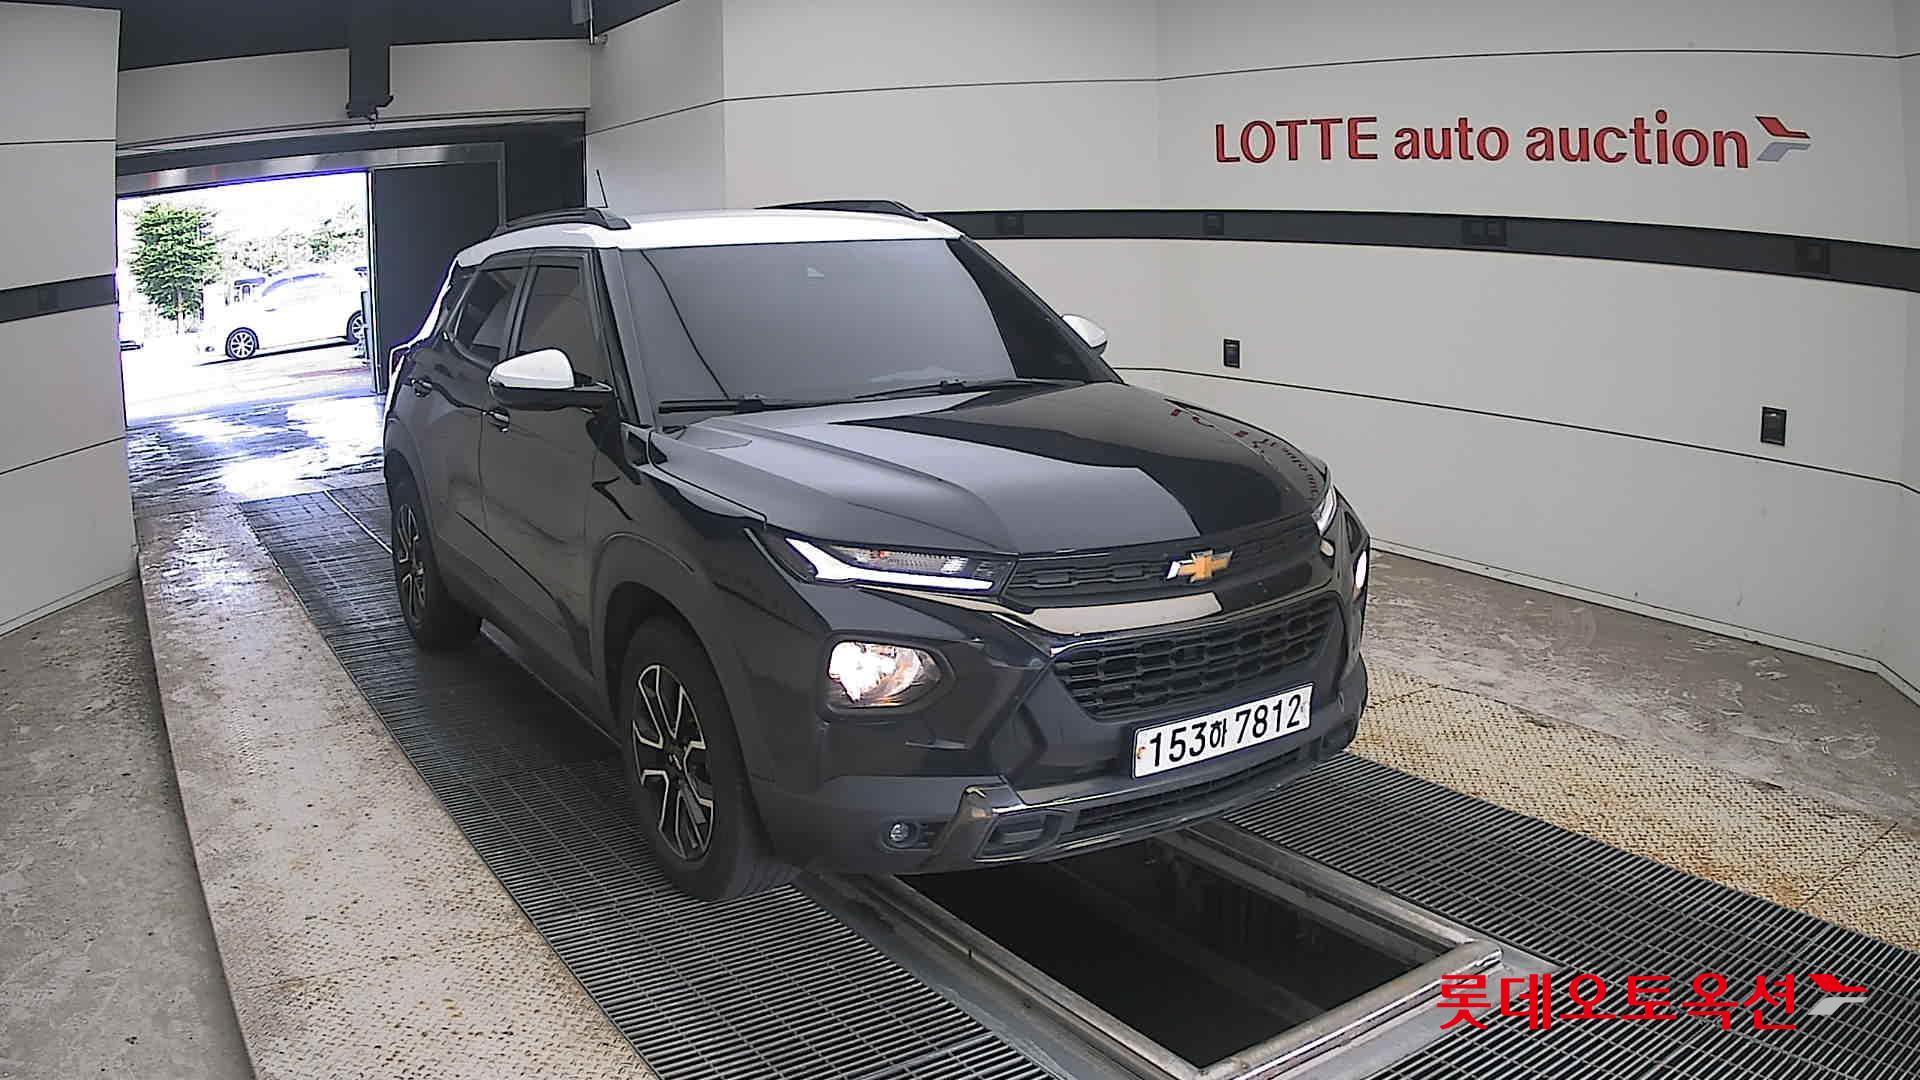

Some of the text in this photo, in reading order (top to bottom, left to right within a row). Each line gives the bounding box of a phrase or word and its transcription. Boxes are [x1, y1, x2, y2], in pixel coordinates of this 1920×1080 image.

[1215, 109, 1749, 169] LOTTE auto auction
[1150, 694, 1302, 767] 153하 7812
